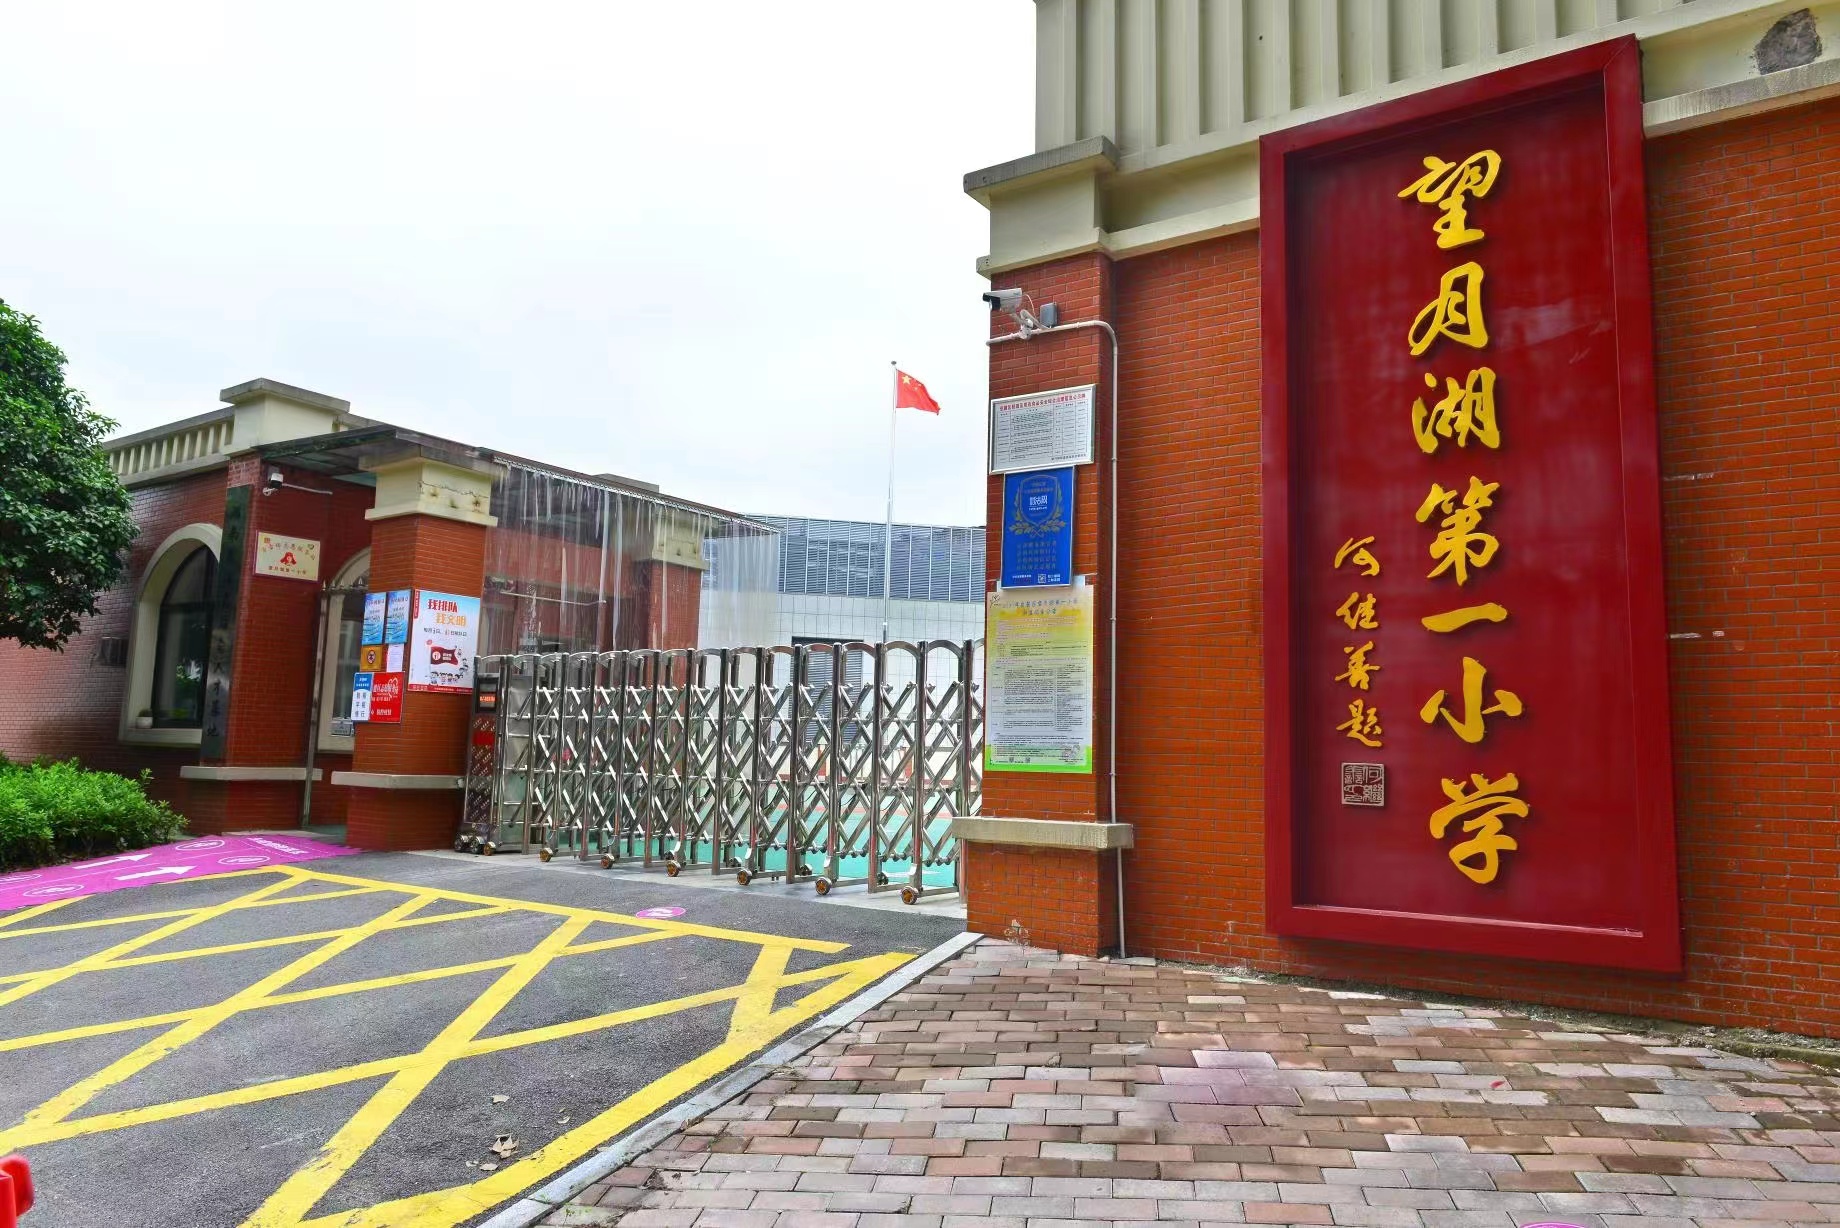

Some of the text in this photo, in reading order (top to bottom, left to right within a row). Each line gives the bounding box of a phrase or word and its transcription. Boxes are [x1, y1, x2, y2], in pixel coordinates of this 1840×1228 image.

[1399, 149, 1530, 885] 望月湖第一小学
